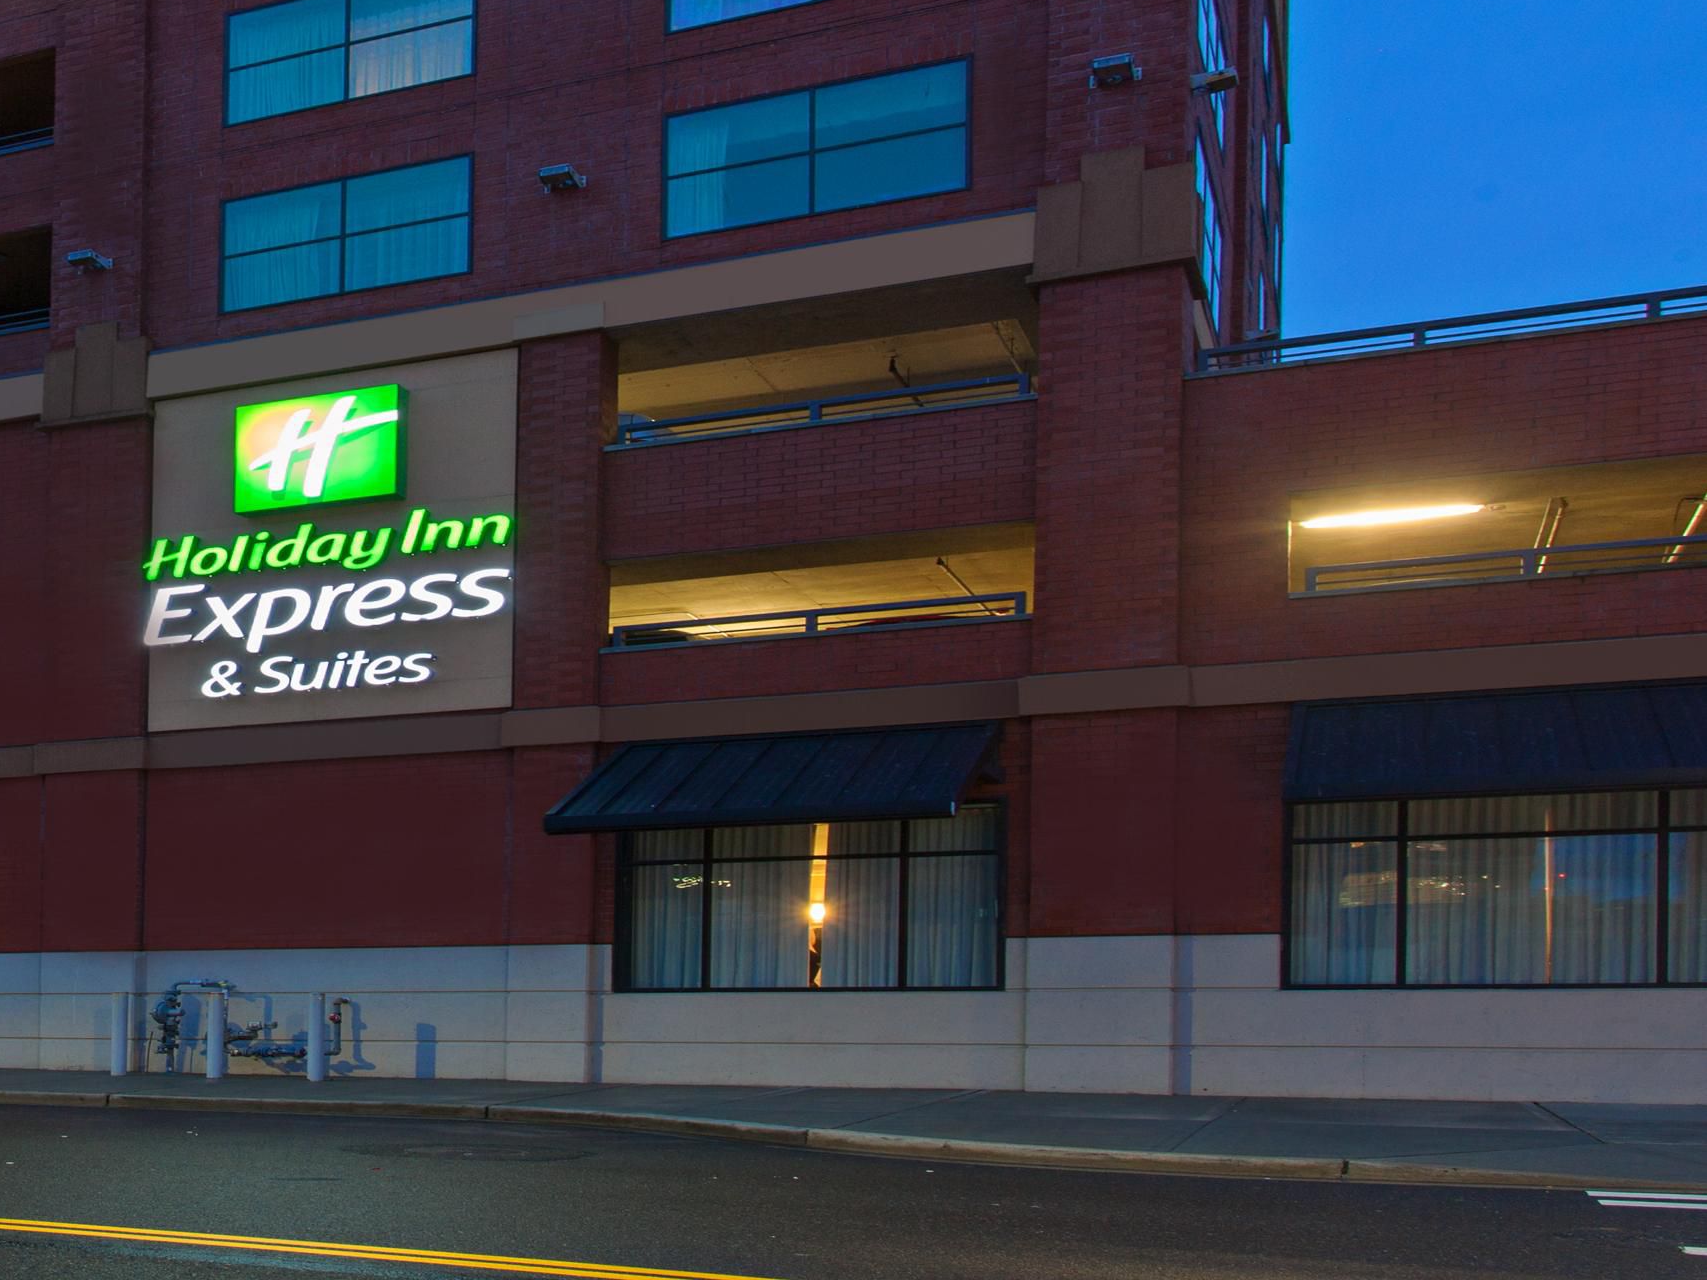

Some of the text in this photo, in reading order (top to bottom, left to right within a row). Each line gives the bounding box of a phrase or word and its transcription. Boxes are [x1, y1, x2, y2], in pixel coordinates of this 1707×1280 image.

[143, 509, 512, 580] Holiday Inn
[144, 569, 510, 653] Express
[201, 650, 433, 698] & Suites
